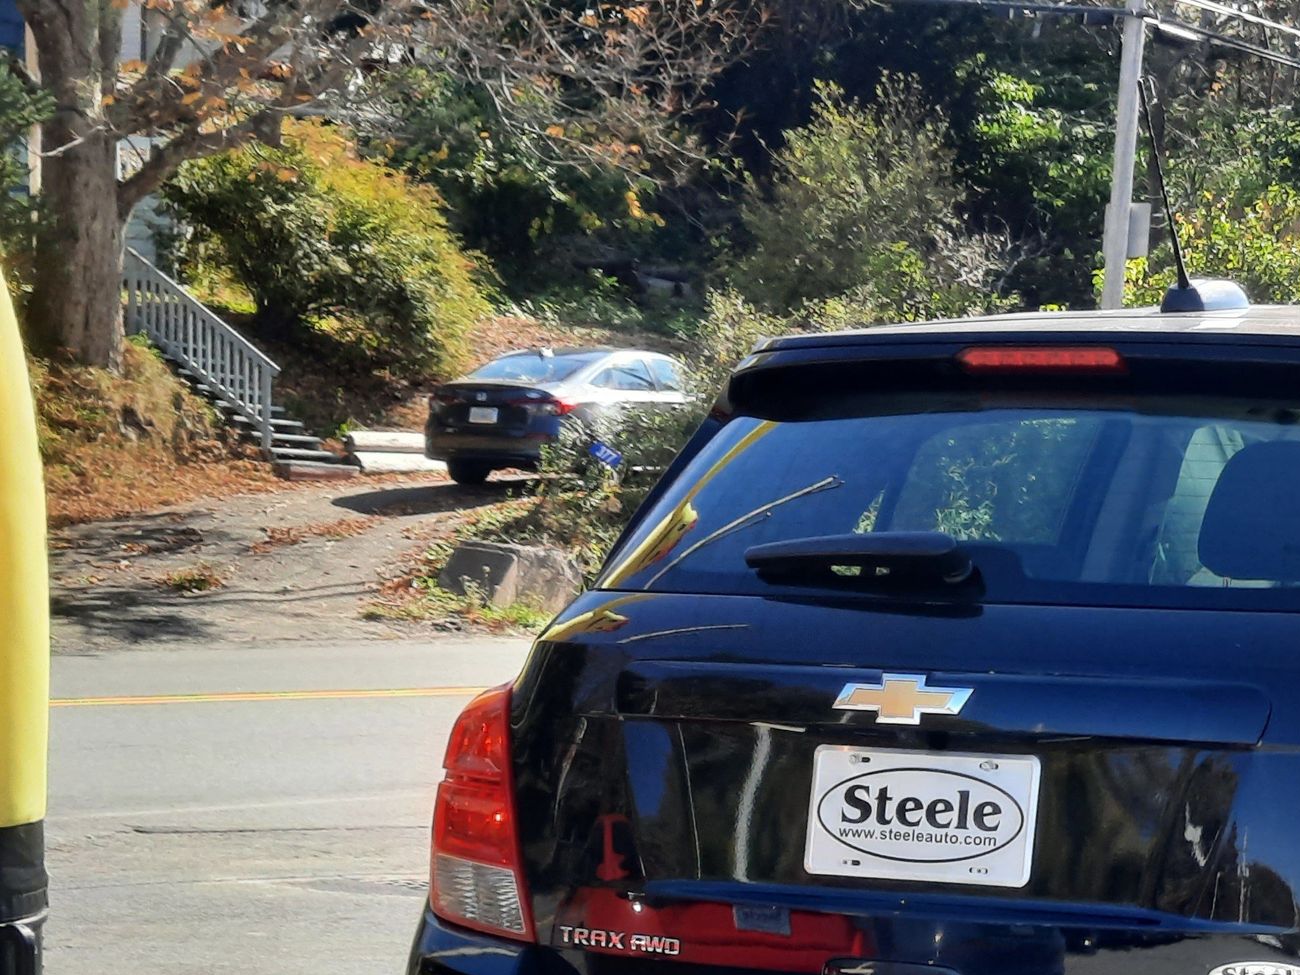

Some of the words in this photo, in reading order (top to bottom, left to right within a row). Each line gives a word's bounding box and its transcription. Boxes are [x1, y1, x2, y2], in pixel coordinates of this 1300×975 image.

[841, 784, 1002, 832] Steele
[838, 826, 997, 847] www.steeleauto.com
[560, 925, 626, 950] TRAX
[630, 933, 681, 956] AWD
